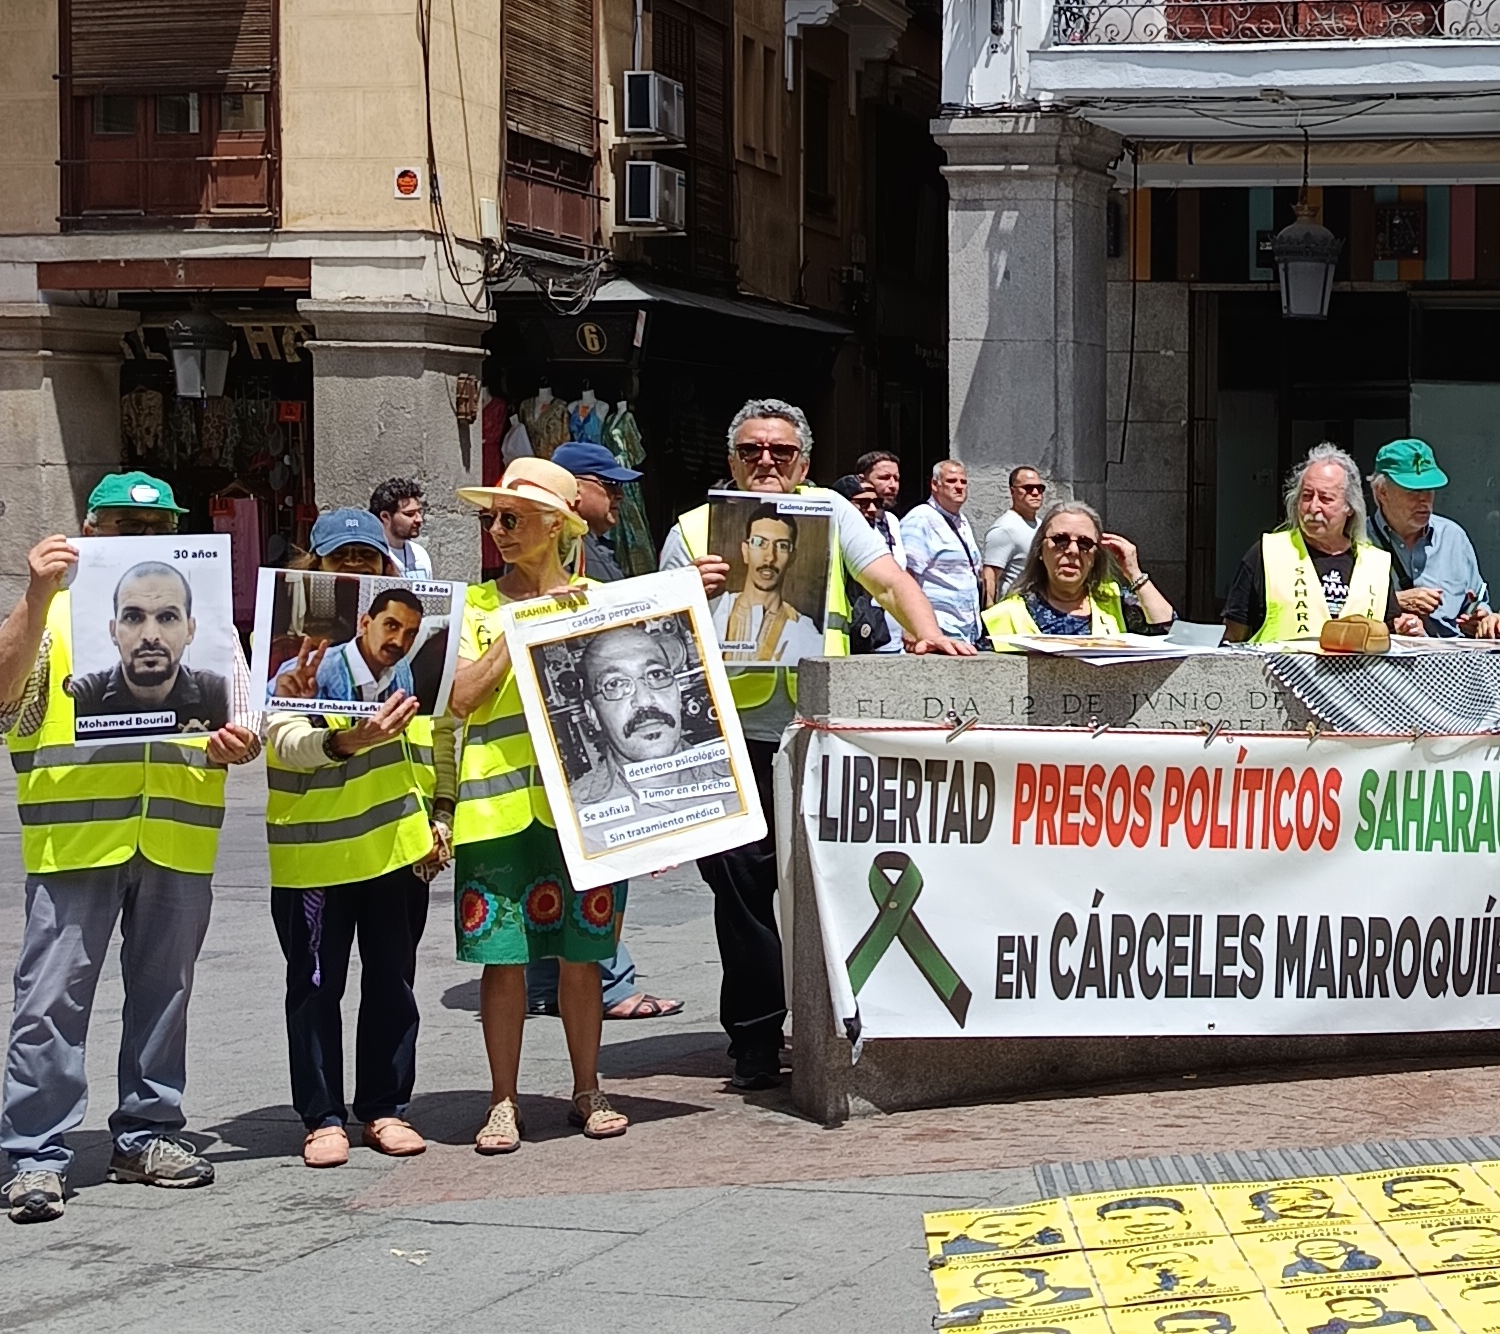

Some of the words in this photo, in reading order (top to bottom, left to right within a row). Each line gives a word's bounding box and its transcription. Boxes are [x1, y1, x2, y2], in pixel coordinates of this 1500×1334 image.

[583, 324, 601, 352] 6
[173, 550, 189, 559] 30
[192, 549, 218, 559] años
[415, 584, 426, 592] 25
[428, 584, 449, 594] años
[1294, 566, 1310, 633] SAHARA
[514, 604, 552, 620] BRAHIM
[572, 614, 606, 628] cadena
[608, 602, 652, 621] perpetua
[271, 699, 317, 710] Mohamed
[318, 701, 358, 712] Embarek
[923, 696, 980, 719] DIA
[1062, 694, 1103, 715] DE
[78, 717, 133, 730] Mohamed
[136, 714, 173, 725] Bourial
[628, 761, 673, 777] deterioro
[675, 748, 726, 767] psicológico
[642, 788, 674, 799] Tumor
[676, 786, 689, 794] en
[690, 783, 700, 792] el
[701, 780, 731, 792] pecho
[818, 754, 995, 845] LIBERTAD
[1010, 761, 1156, 848] PRESOS
[1160, 746, 1342, 852] POLÍTICOS
[584, 812, 596, 822] Se
[599, 804, 630, 819] asfixia
[609, 829, 625, 843] Sin
[627, 817, 684, 839] tratamiento
[686, 806, 720, 822] médico
[994, 933, 1037, 1000] EN
[1049, 887, 1265, 1002] CÁRCELES
